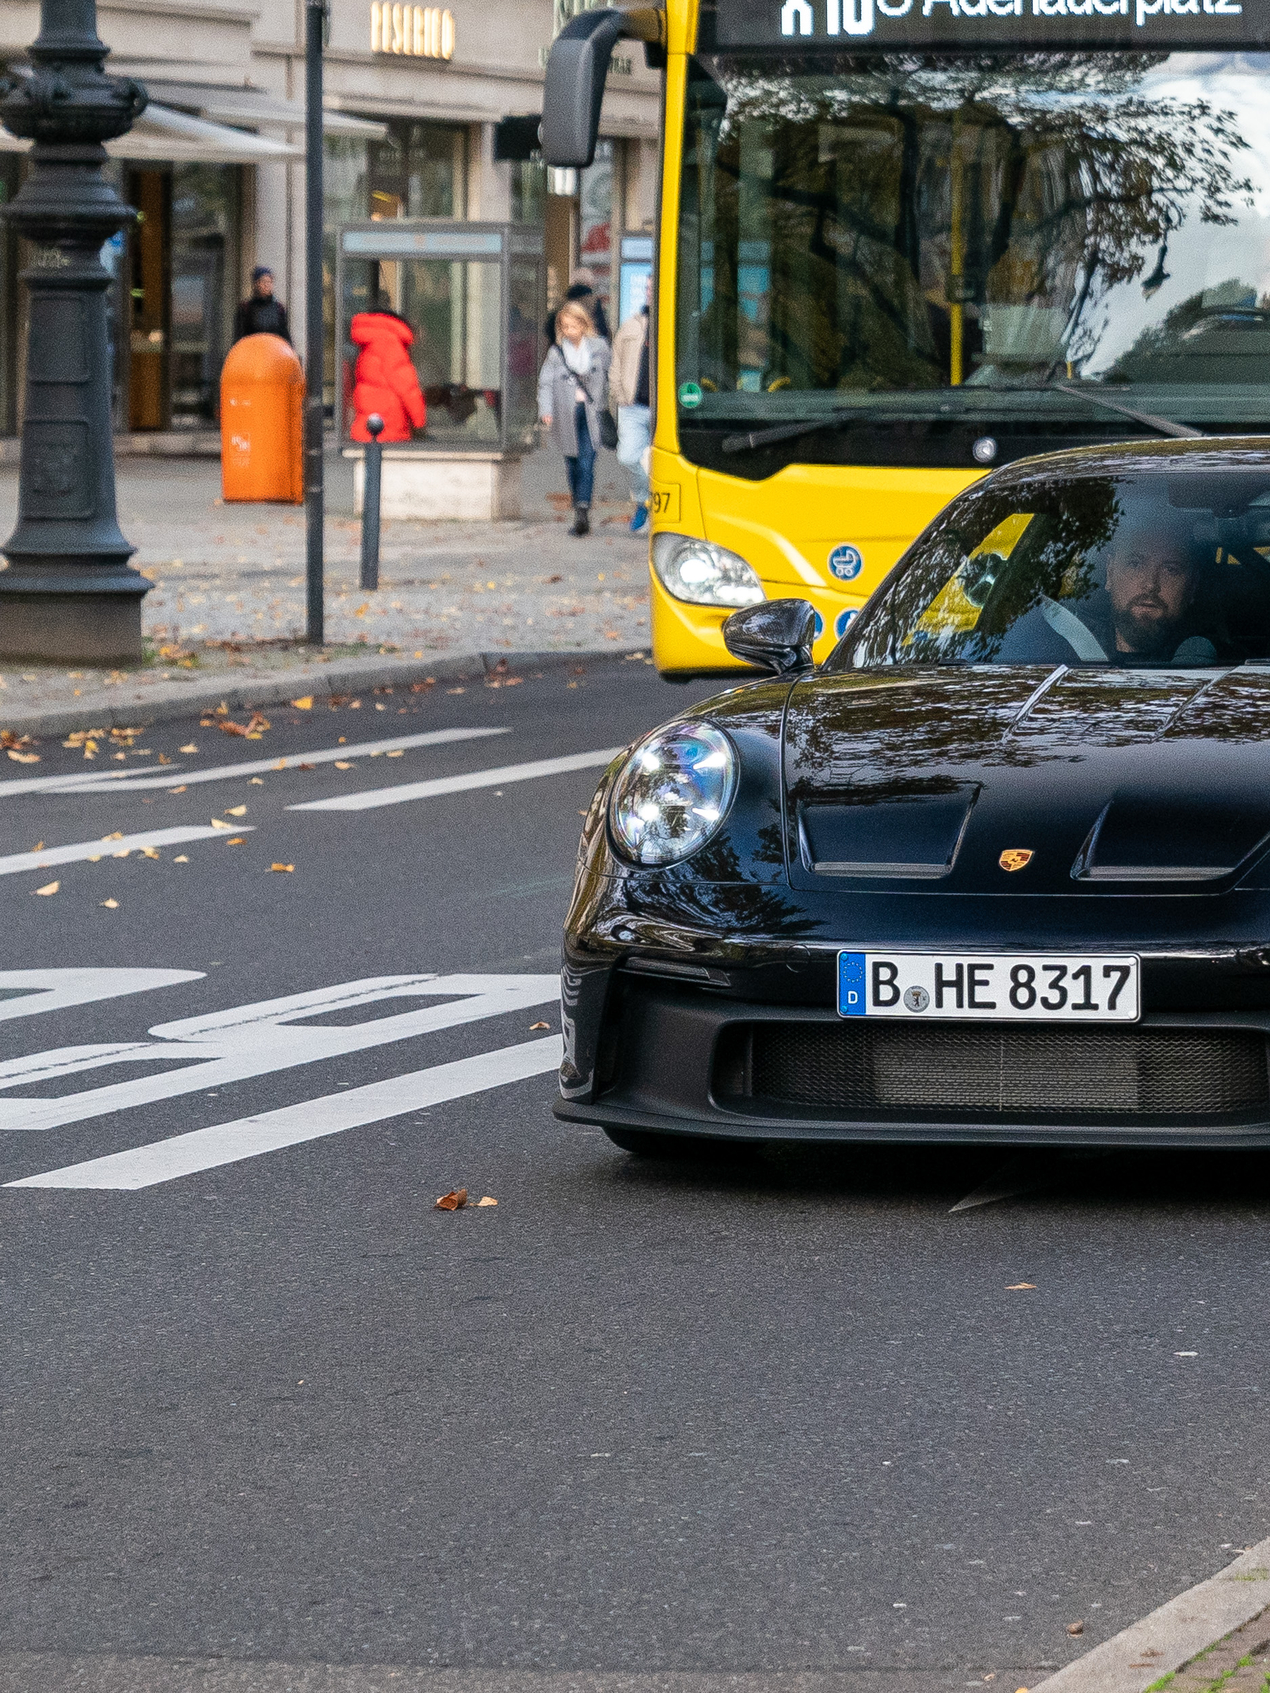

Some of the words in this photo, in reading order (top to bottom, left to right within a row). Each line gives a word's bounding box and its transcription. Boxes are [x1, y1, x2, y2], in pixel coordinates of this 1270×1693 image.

[650, 491, 671, 514] 97
[847, 990, 858, 1004] D
[872, 961, 901, 1007] B
[935, 963, 997, 1009] HE
[1009, 964, 1131, 1011] 8317
